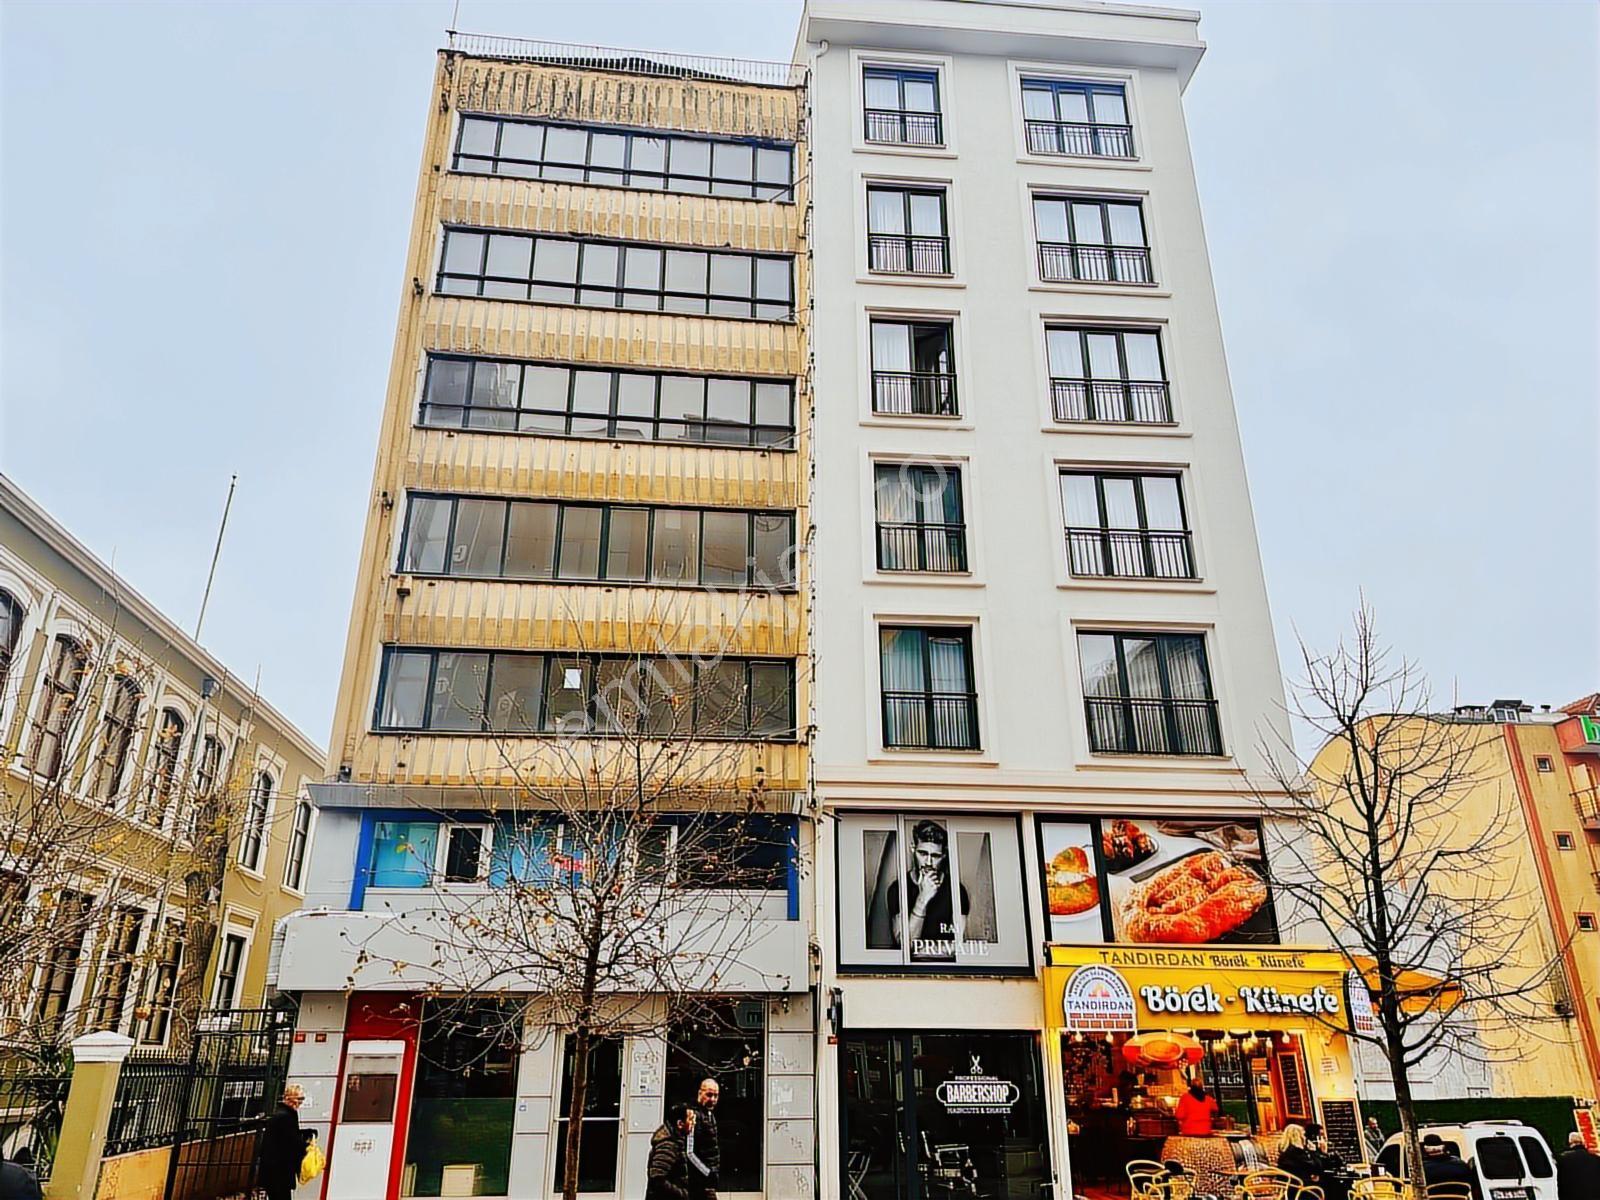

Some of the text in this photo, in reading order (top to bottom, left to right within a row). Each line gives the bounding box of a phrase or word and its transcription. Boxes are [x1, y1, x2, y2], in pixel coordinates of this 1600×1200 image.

[911, 939, 990, 955] PRIVATE
[1099, 951, 1204, 966] TANDIRDAN
[1209, 954, 1249, 967] Börek
[1257, 955, 1305, 968] Künefe
[1067, 1000, 1133, 1010] TANDIRDAN
[1140, 984, 1224, 1013] Börek
[1239, 985, 1340, 1013] Künefe
[946, 1084, 1010, 1103] BARBERSHOP
